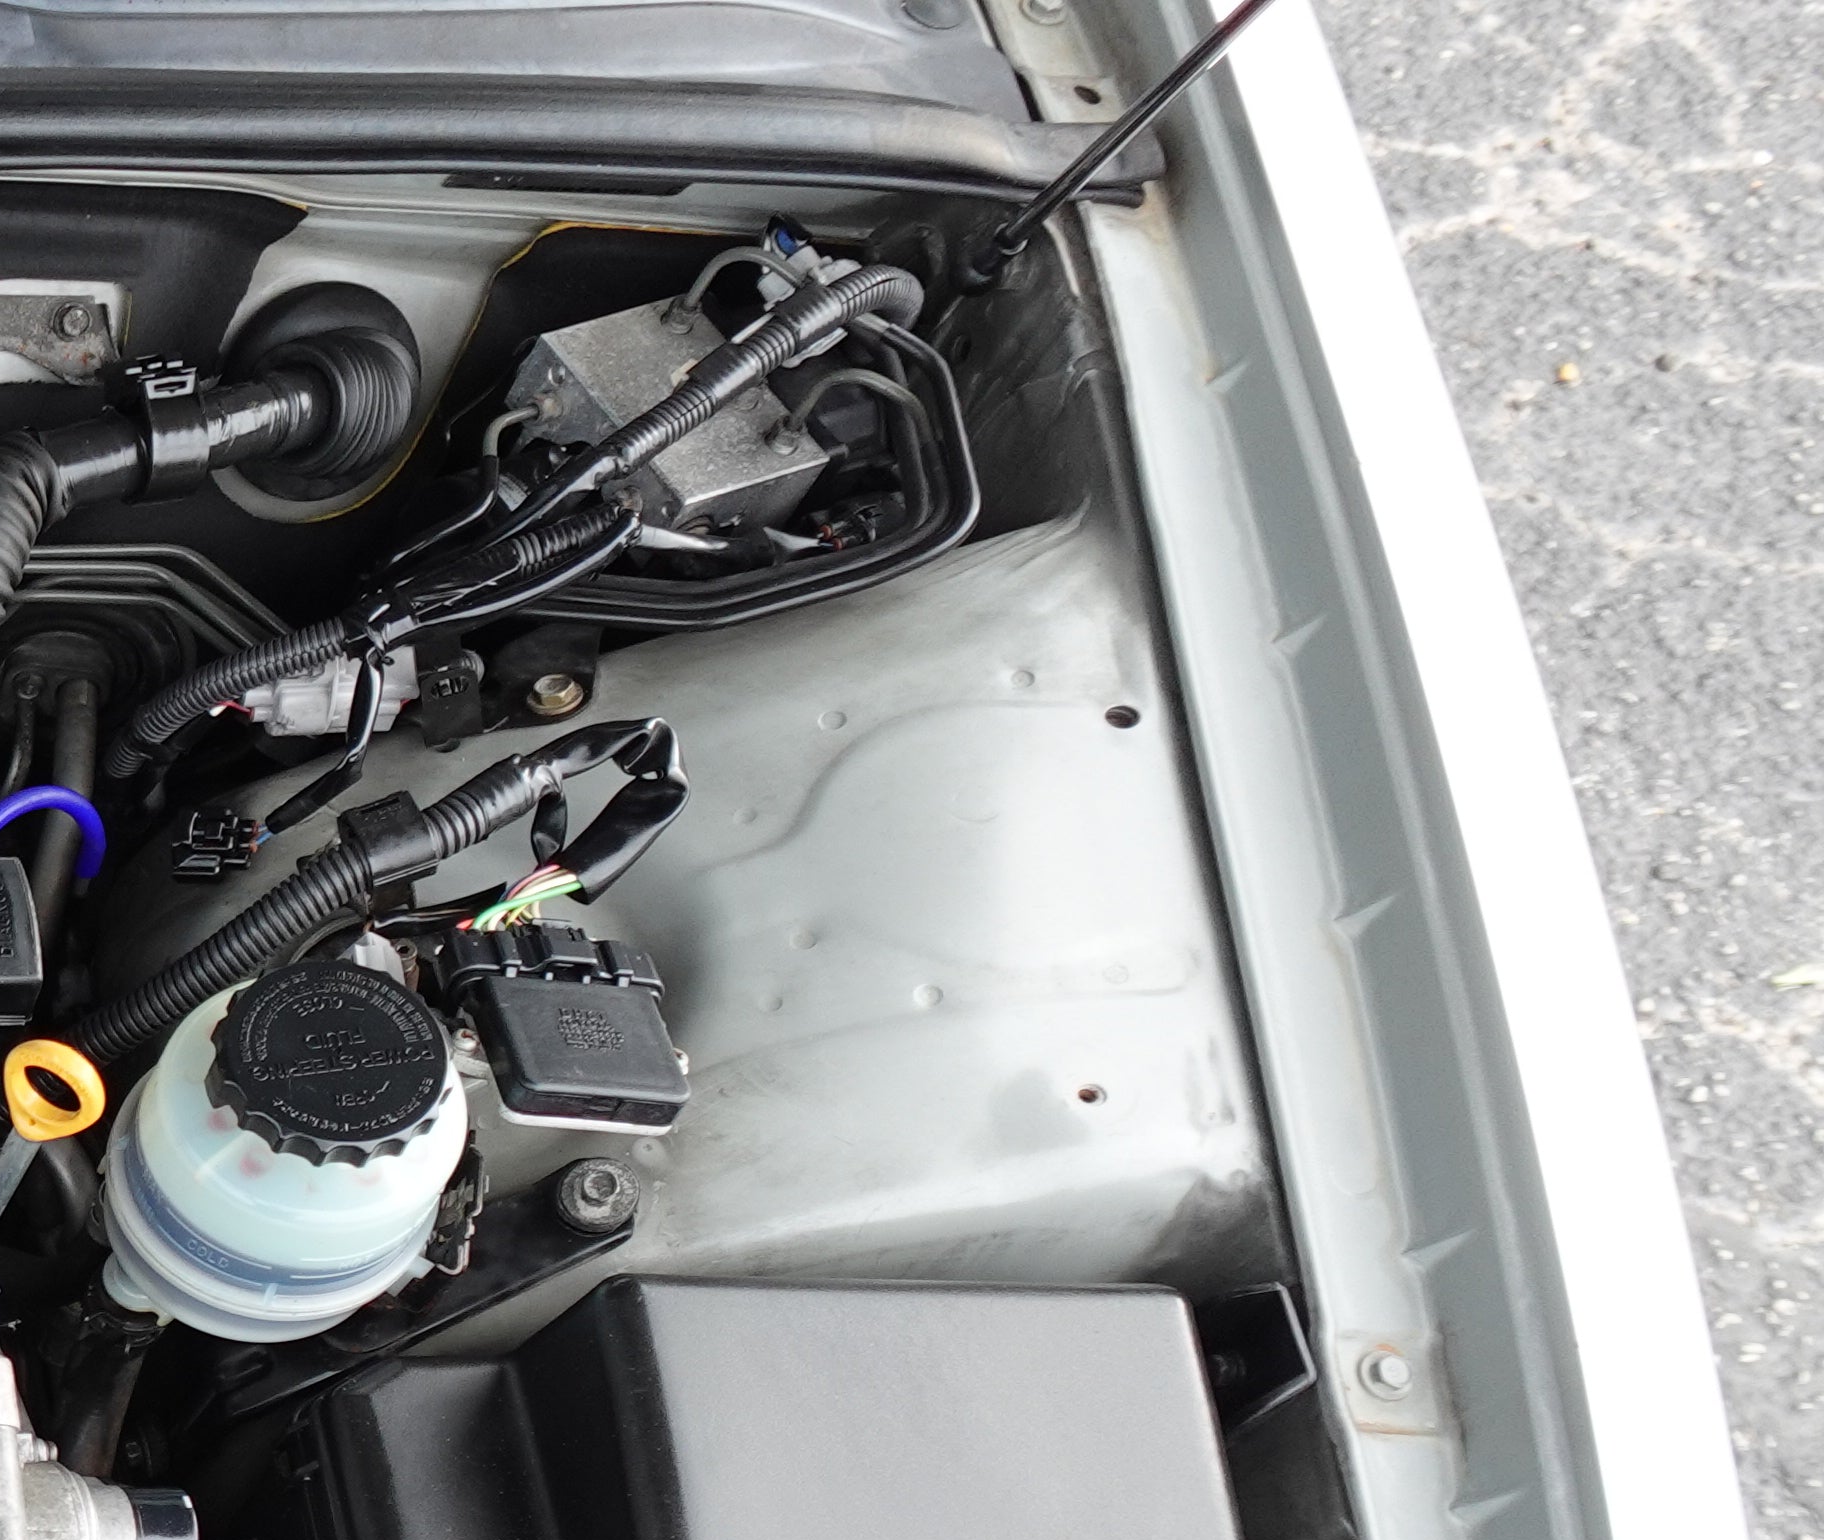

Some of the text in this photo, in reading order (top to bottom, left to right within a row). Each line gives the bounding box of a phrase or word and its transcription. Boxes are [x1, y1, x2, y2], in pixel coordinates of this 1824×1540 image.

[304, 1028, 367, 1050] FLUID
[253, 1052, 358, 1082] STEERING
[186, 1238, 229, 1269] COLD
